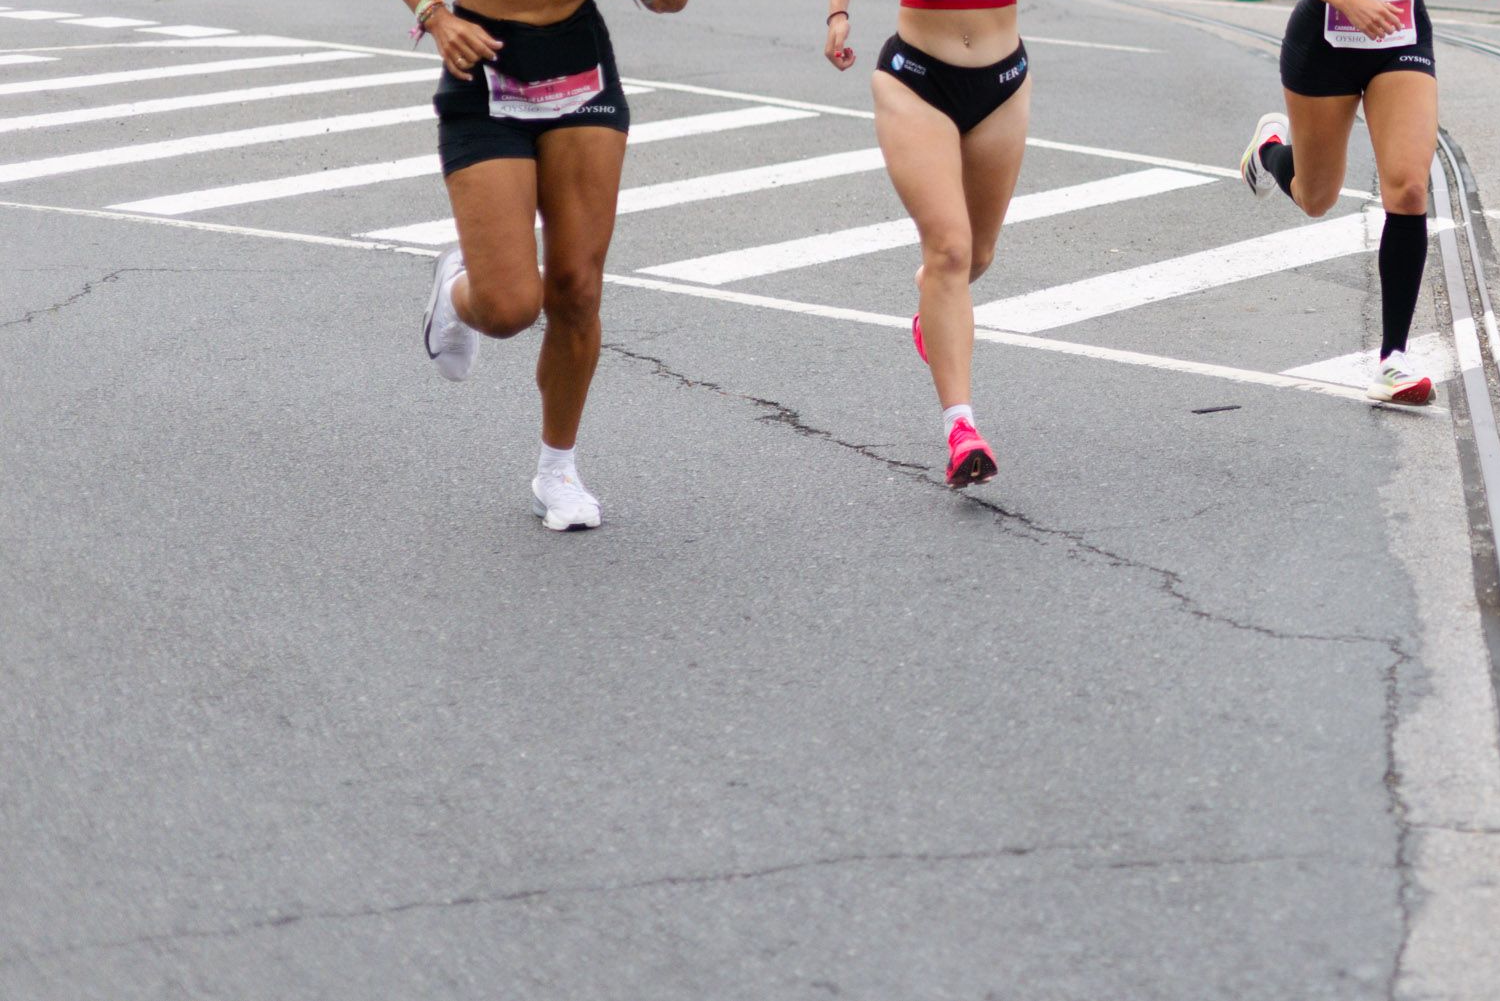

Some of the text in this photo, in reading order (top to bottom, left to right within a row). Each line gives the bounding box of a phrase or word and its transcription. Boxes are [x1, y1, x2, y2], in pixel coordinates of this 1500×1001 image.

[1335, 35, 1366, 43] OYSHO
[1399, 55, 1432, 66] OYSHO
[576, 106, 616, 114] OYSHO
